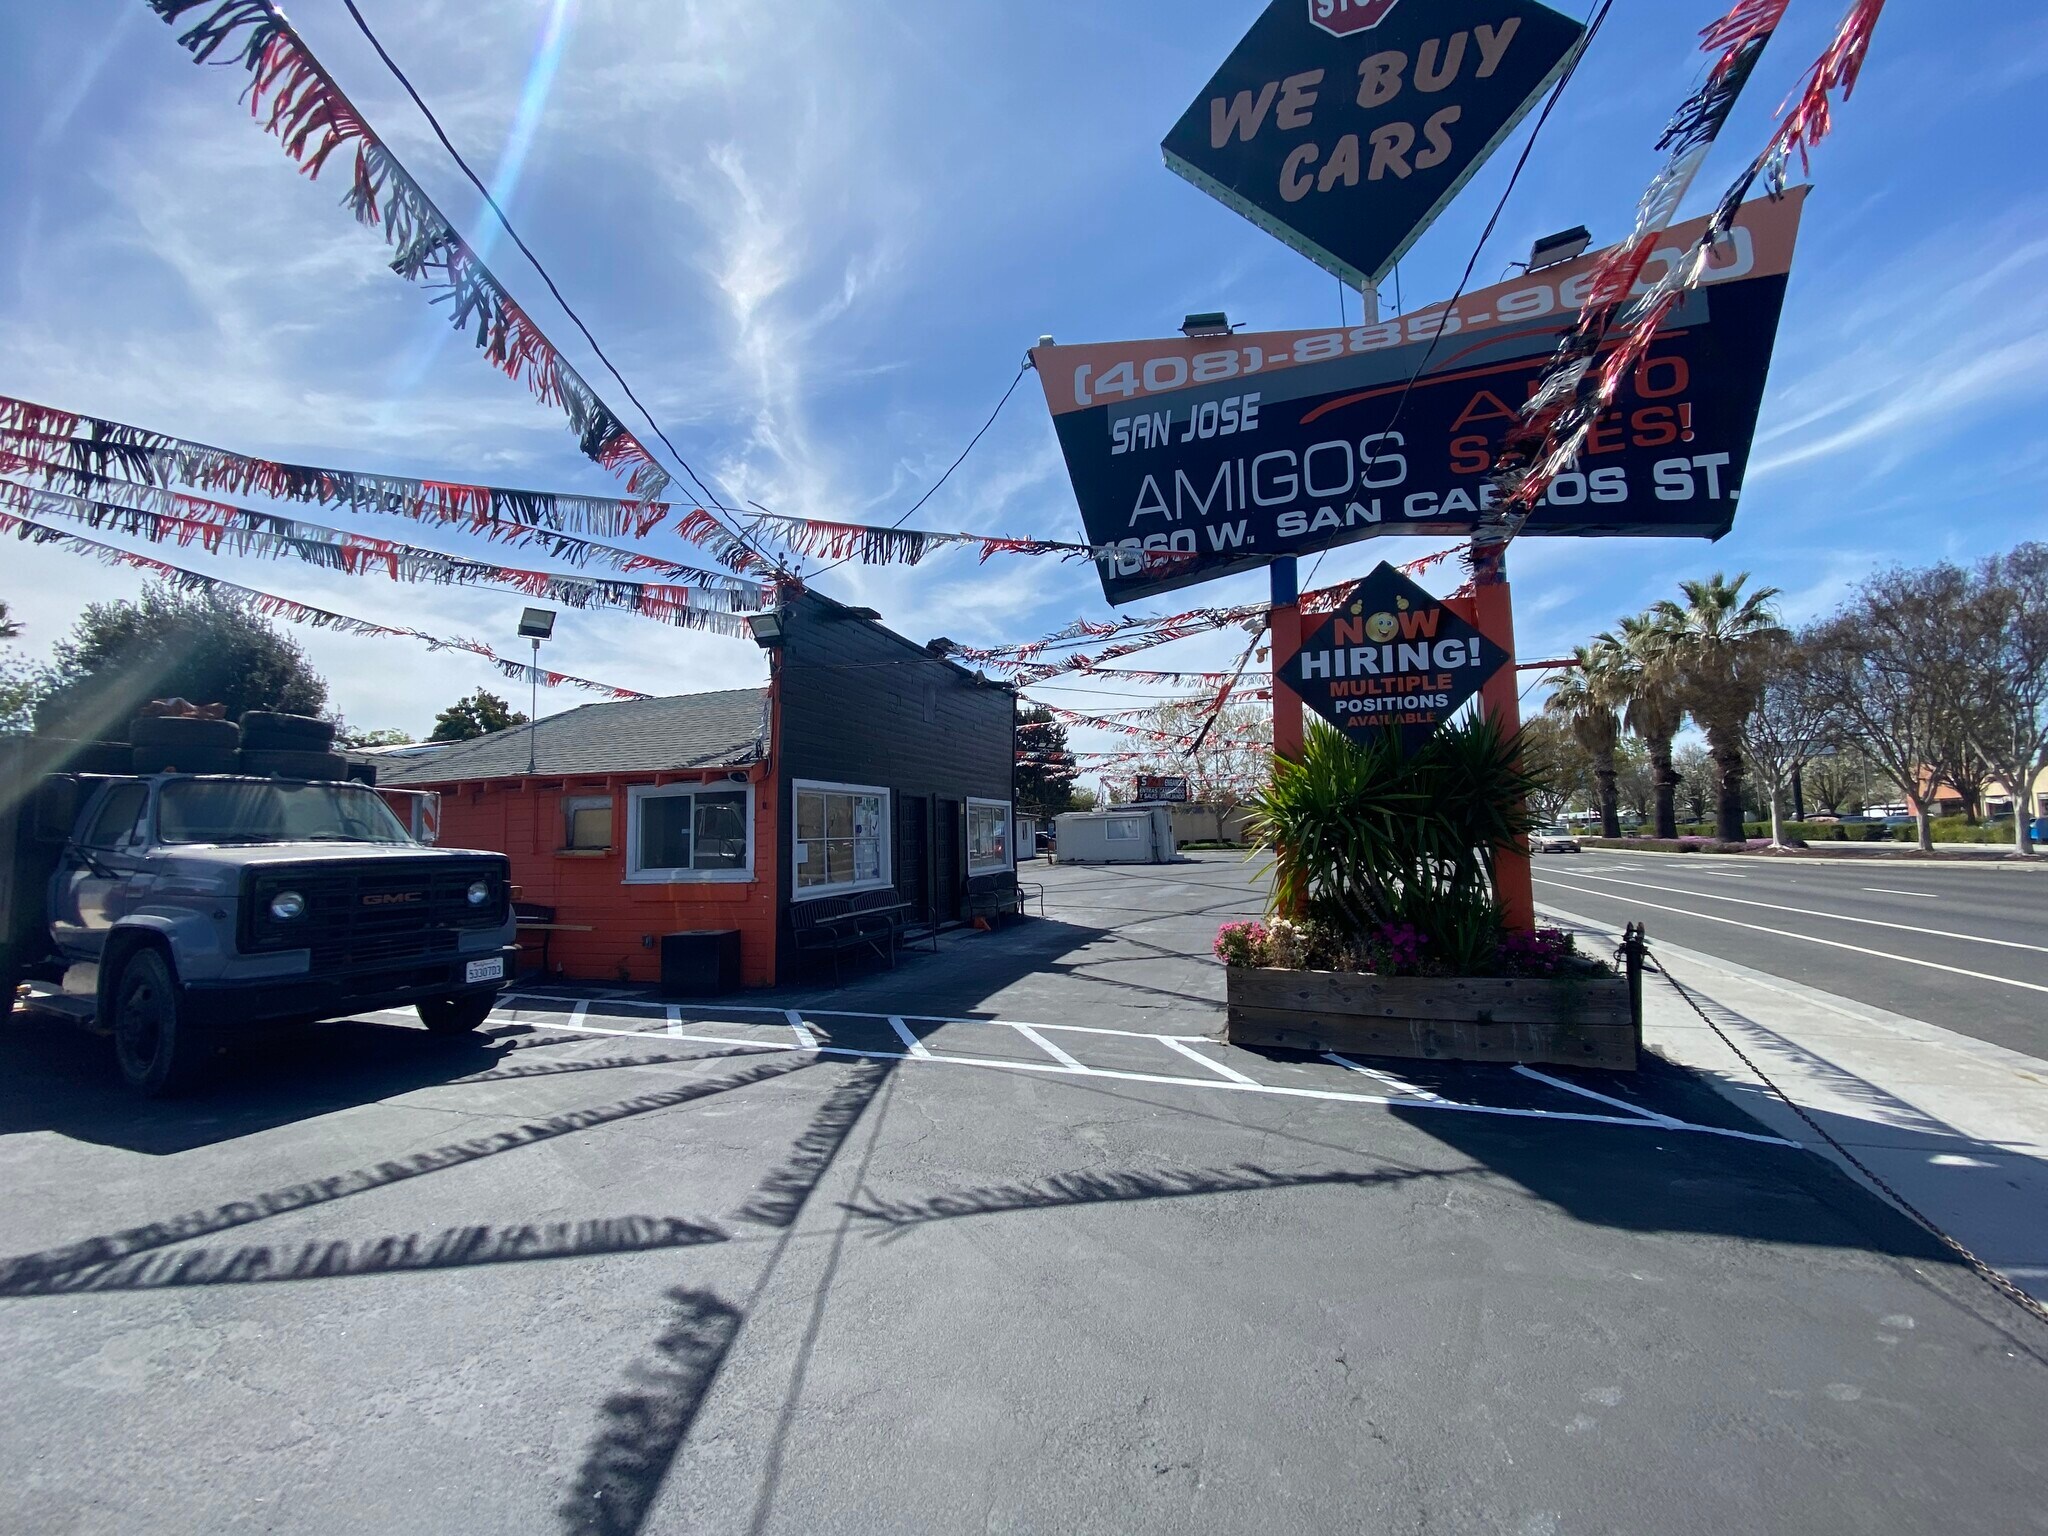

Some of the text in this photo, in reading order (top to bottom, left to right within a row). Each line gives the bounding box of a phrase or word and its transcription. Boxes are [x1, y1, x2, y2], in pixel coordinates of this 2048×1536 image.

[1210, 17, 1522, 148] WE BUY
[1279, 105, 1461, 202] CARS
[1111, 392, 1261, 455] SAN JOSE
[1449, 355, 1690, 432] AO
[1449, 402, 1695, 474] SES!
[1128, 431, 1407, 527] AMIGOS
[1206, 519, 1255, 552] W.
[1277, 499, 1382, 537] SAN
[1403, 466, 1628, 518] CAOS
[1653, 452, 1742, 501] ST.
[1301, 637, 1481, 680] HIRING!
[1334, 608, 1439, 646] NOW
[1330, 673, 1453, 697] MULTIPLE
[1335, 693, 1449, 714] POSITIONS
[1347, 711, 1437, 727] AVAILABLE
[362, 892, 422, 905] GMC
